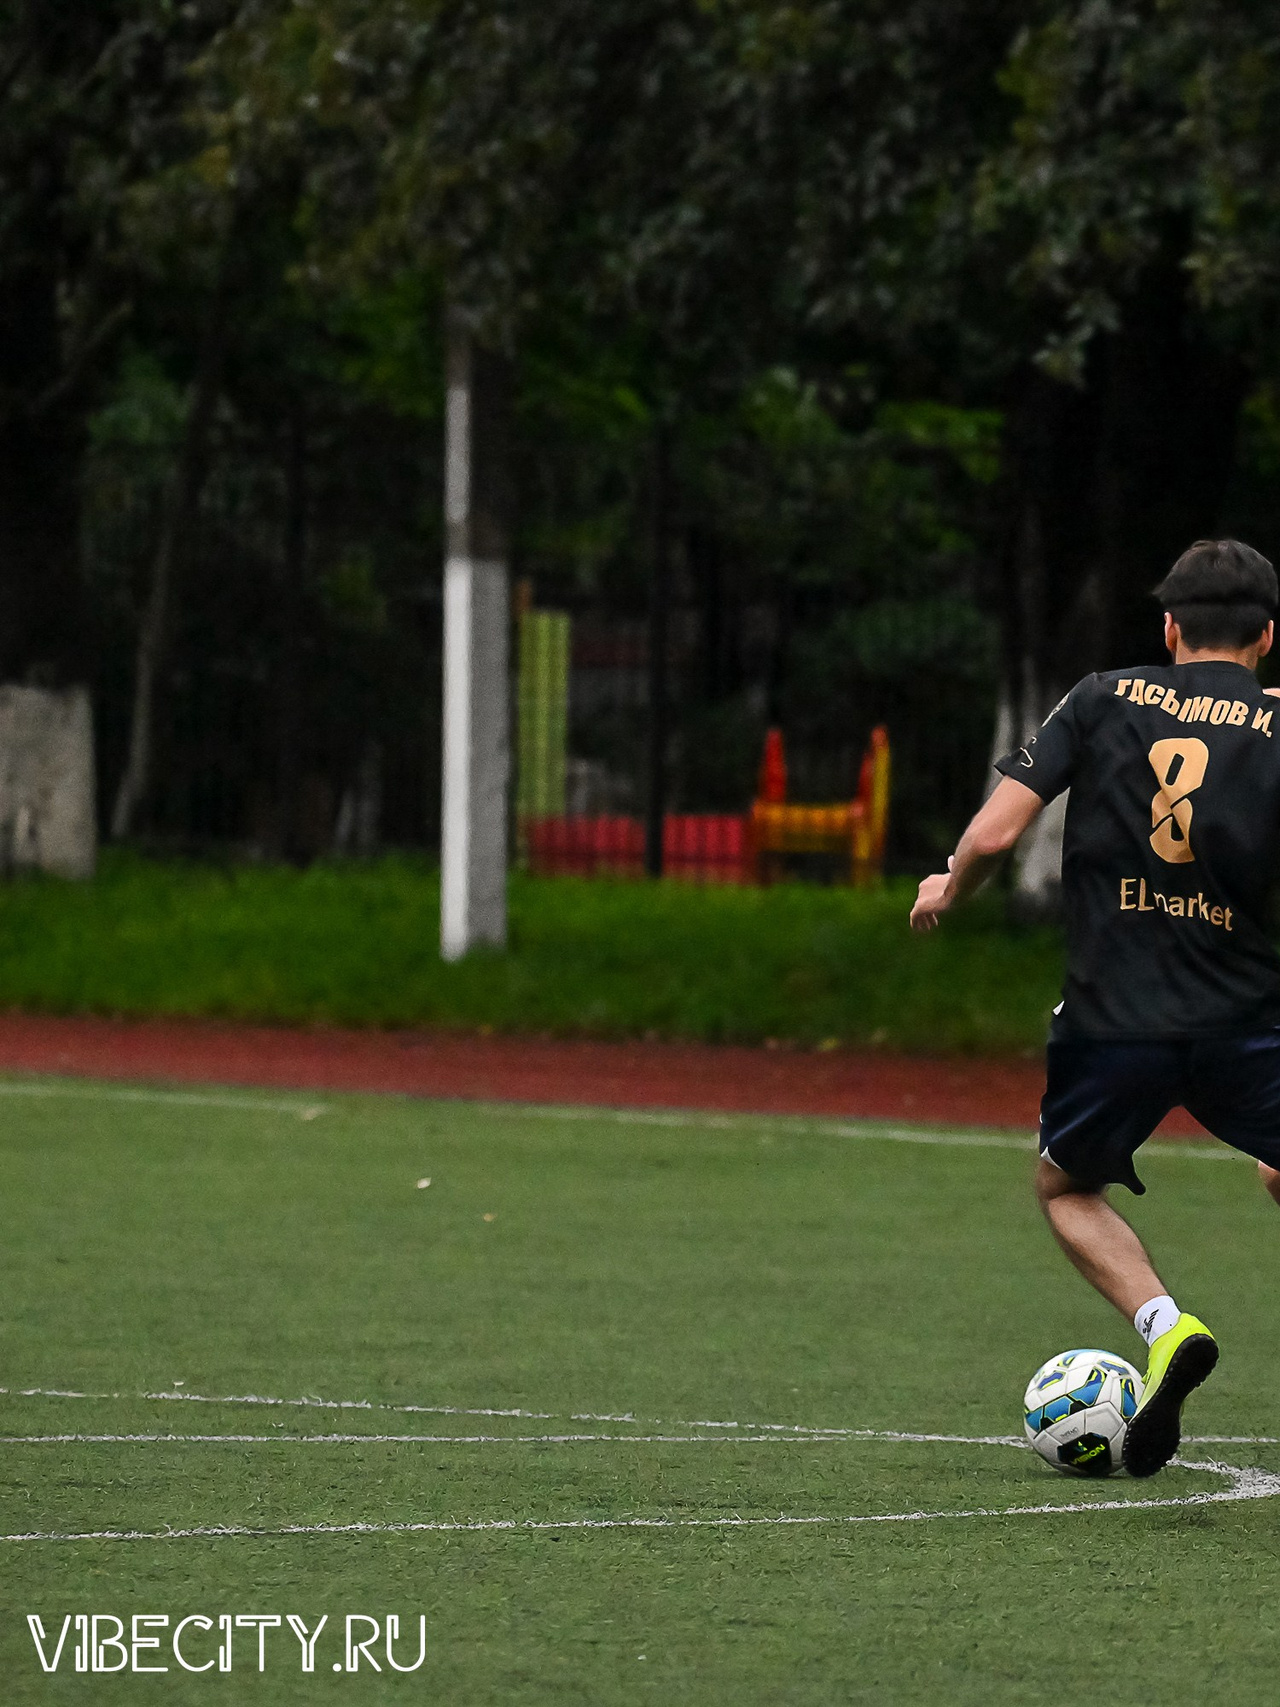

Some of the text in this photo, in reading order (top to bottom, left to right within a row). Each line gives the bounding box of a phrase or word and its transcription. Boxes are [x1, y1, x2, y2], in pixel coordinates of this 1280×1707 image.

[1114, 678, 1249, 726] ГАСЫМОВ
[1251, 707, 1274, 738] И.
[1148, 737, 1210, 864] 8
